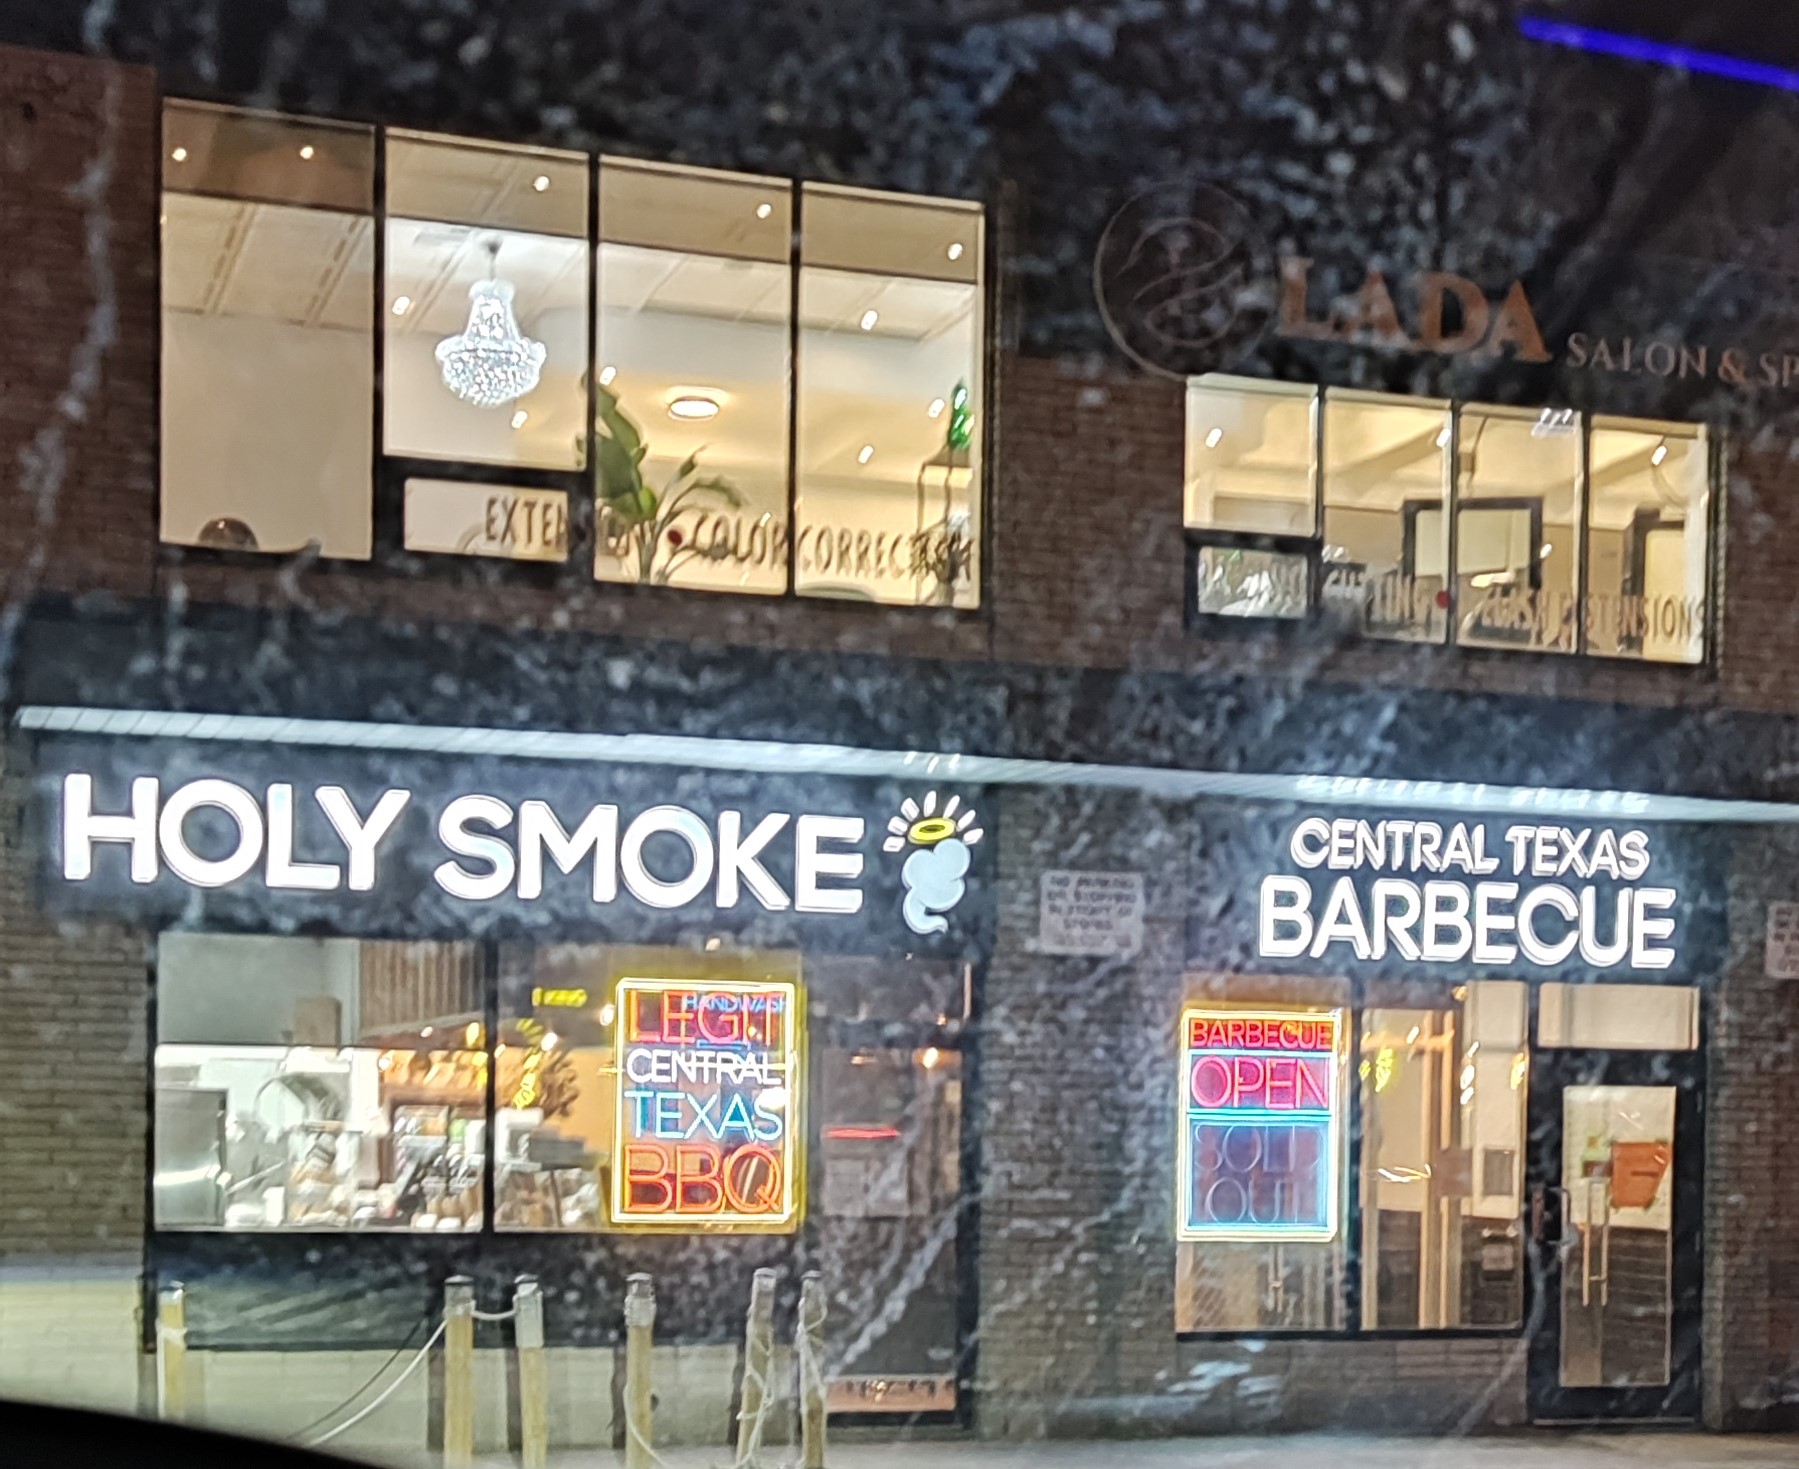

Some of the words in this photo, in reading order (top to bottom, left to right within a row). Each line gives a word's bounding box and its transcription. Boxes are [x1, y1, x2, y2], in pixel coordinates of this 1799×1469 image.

[1275, 256, 1553, 362] LADA
[1566, 332, 1707, 379] SALON
[1716, 346, 1748, 385] &
[797, 524, 973, 588] CORREC
[63, 773, 411, 891] HOLY
[433, 794, 865, 914] SMOKE
[1290, 817, 1500, 875] CENTRAL
[1505, 824, 1651, 881] TEXAS
[1258, 875, 1676, 969] BARBECUE
[628, 988, 785, 1046] LEGIT
[1190, 1018, 1332, 1050] BARBECUE
[626, 1048, 782, 1085] CENTRAL
[1191, 1055, 1331, 1109] OPEN
[624, 1090, 782, 1141] TEXAS
[624, 1143, 782, 1213] BBQ
